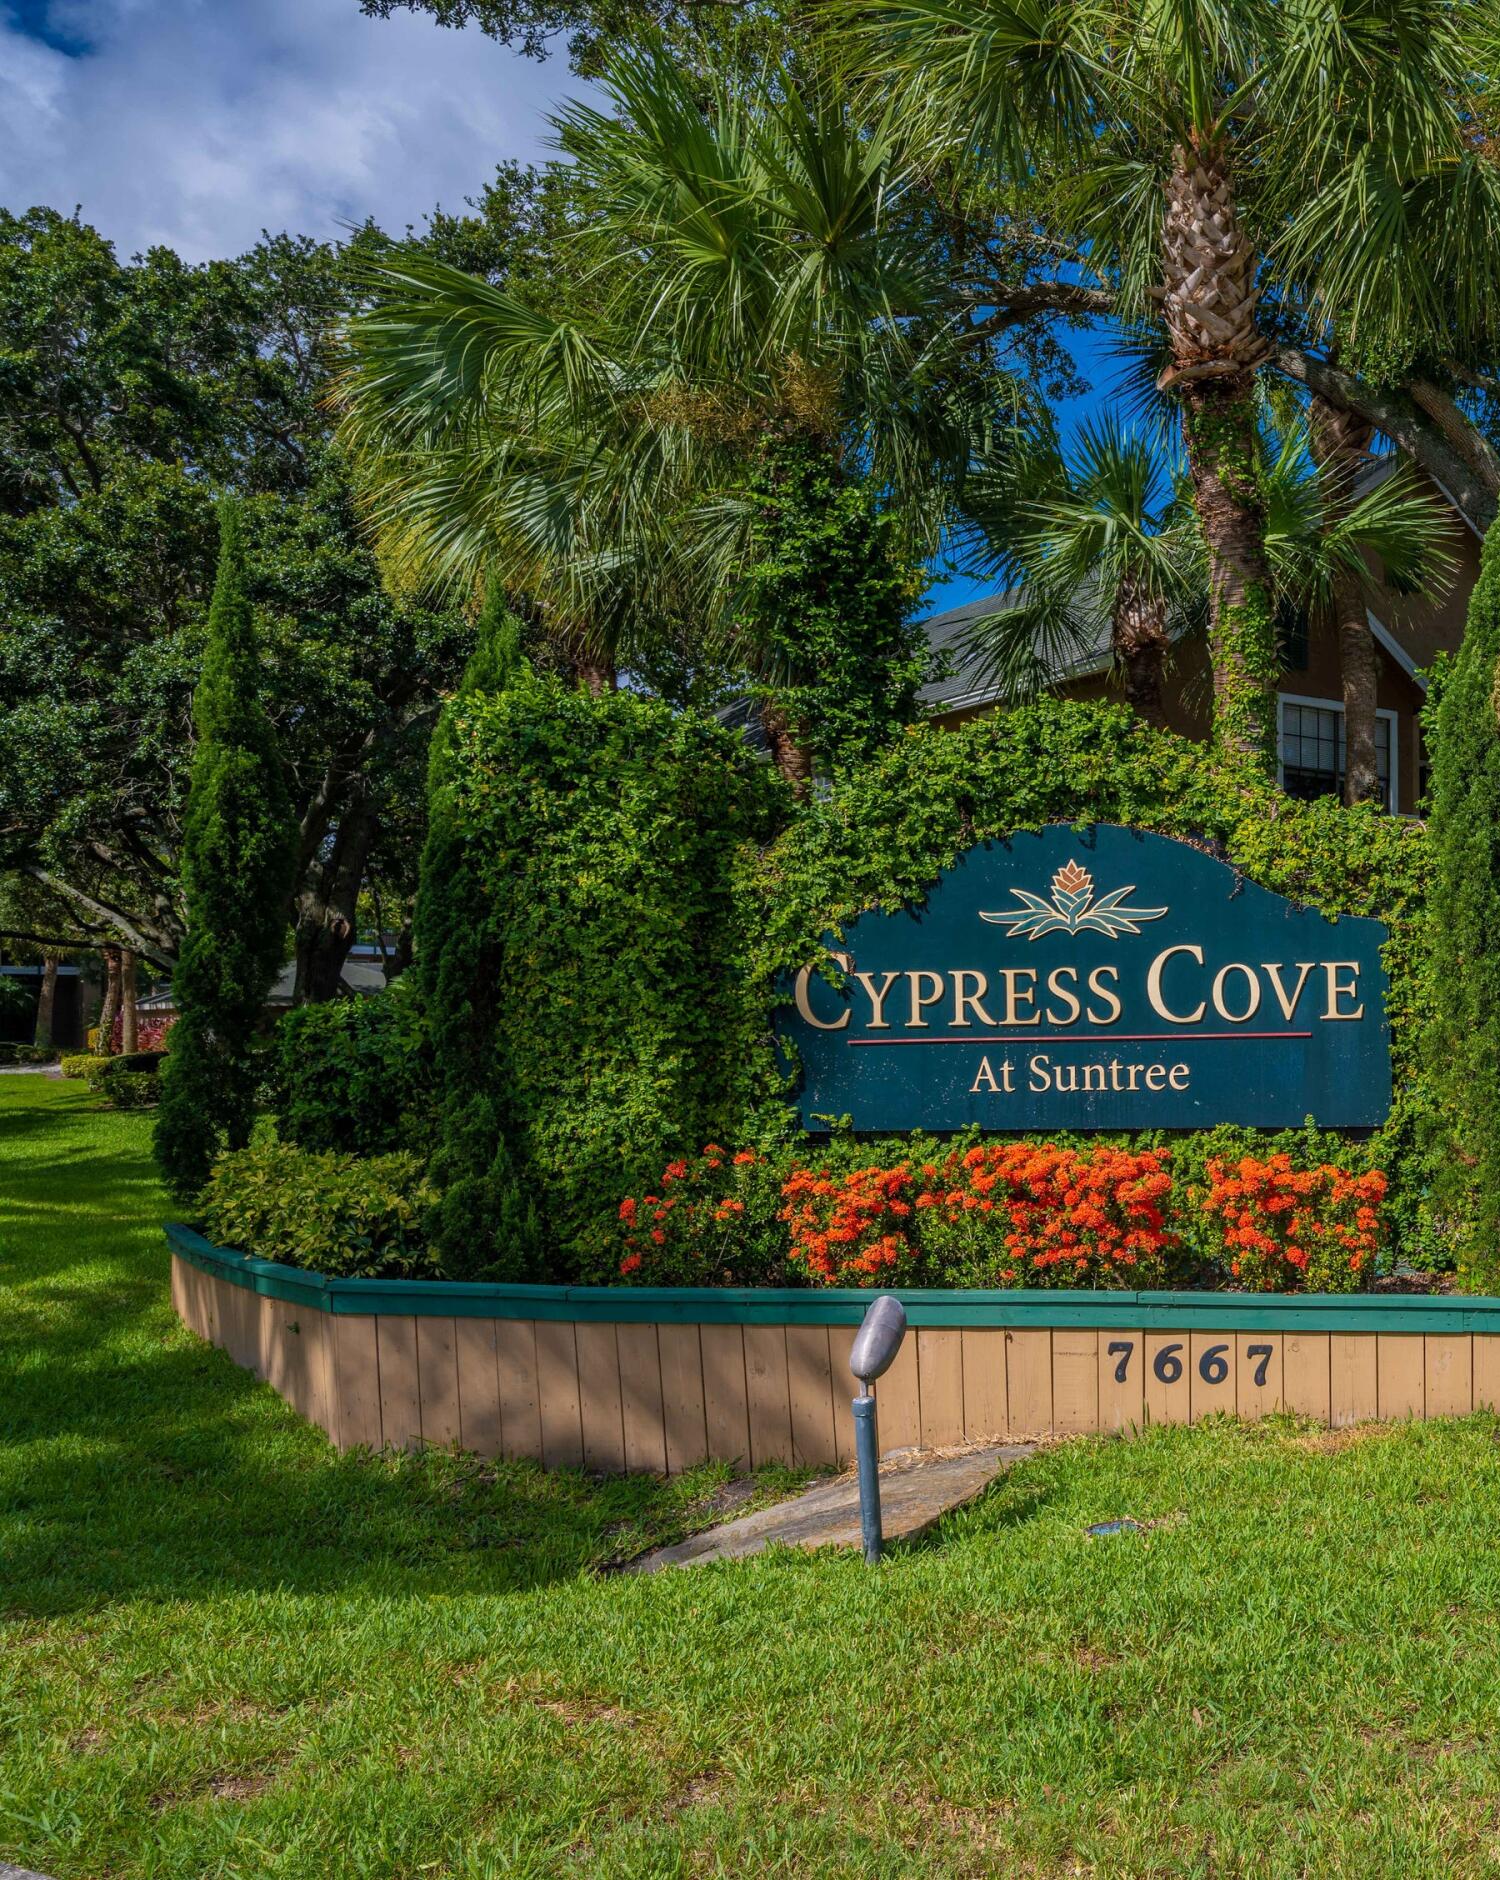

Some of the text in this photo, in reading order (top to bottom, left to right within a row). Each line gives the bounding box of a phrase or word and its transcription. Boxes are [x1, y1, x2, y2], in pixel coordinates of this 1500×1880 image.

[795, 945, 1365, 1031] CYPRESS COVE
[970, 1055, 1191, 1093] At Suntree
[1108, 1341, 1273, 1387] 7667
